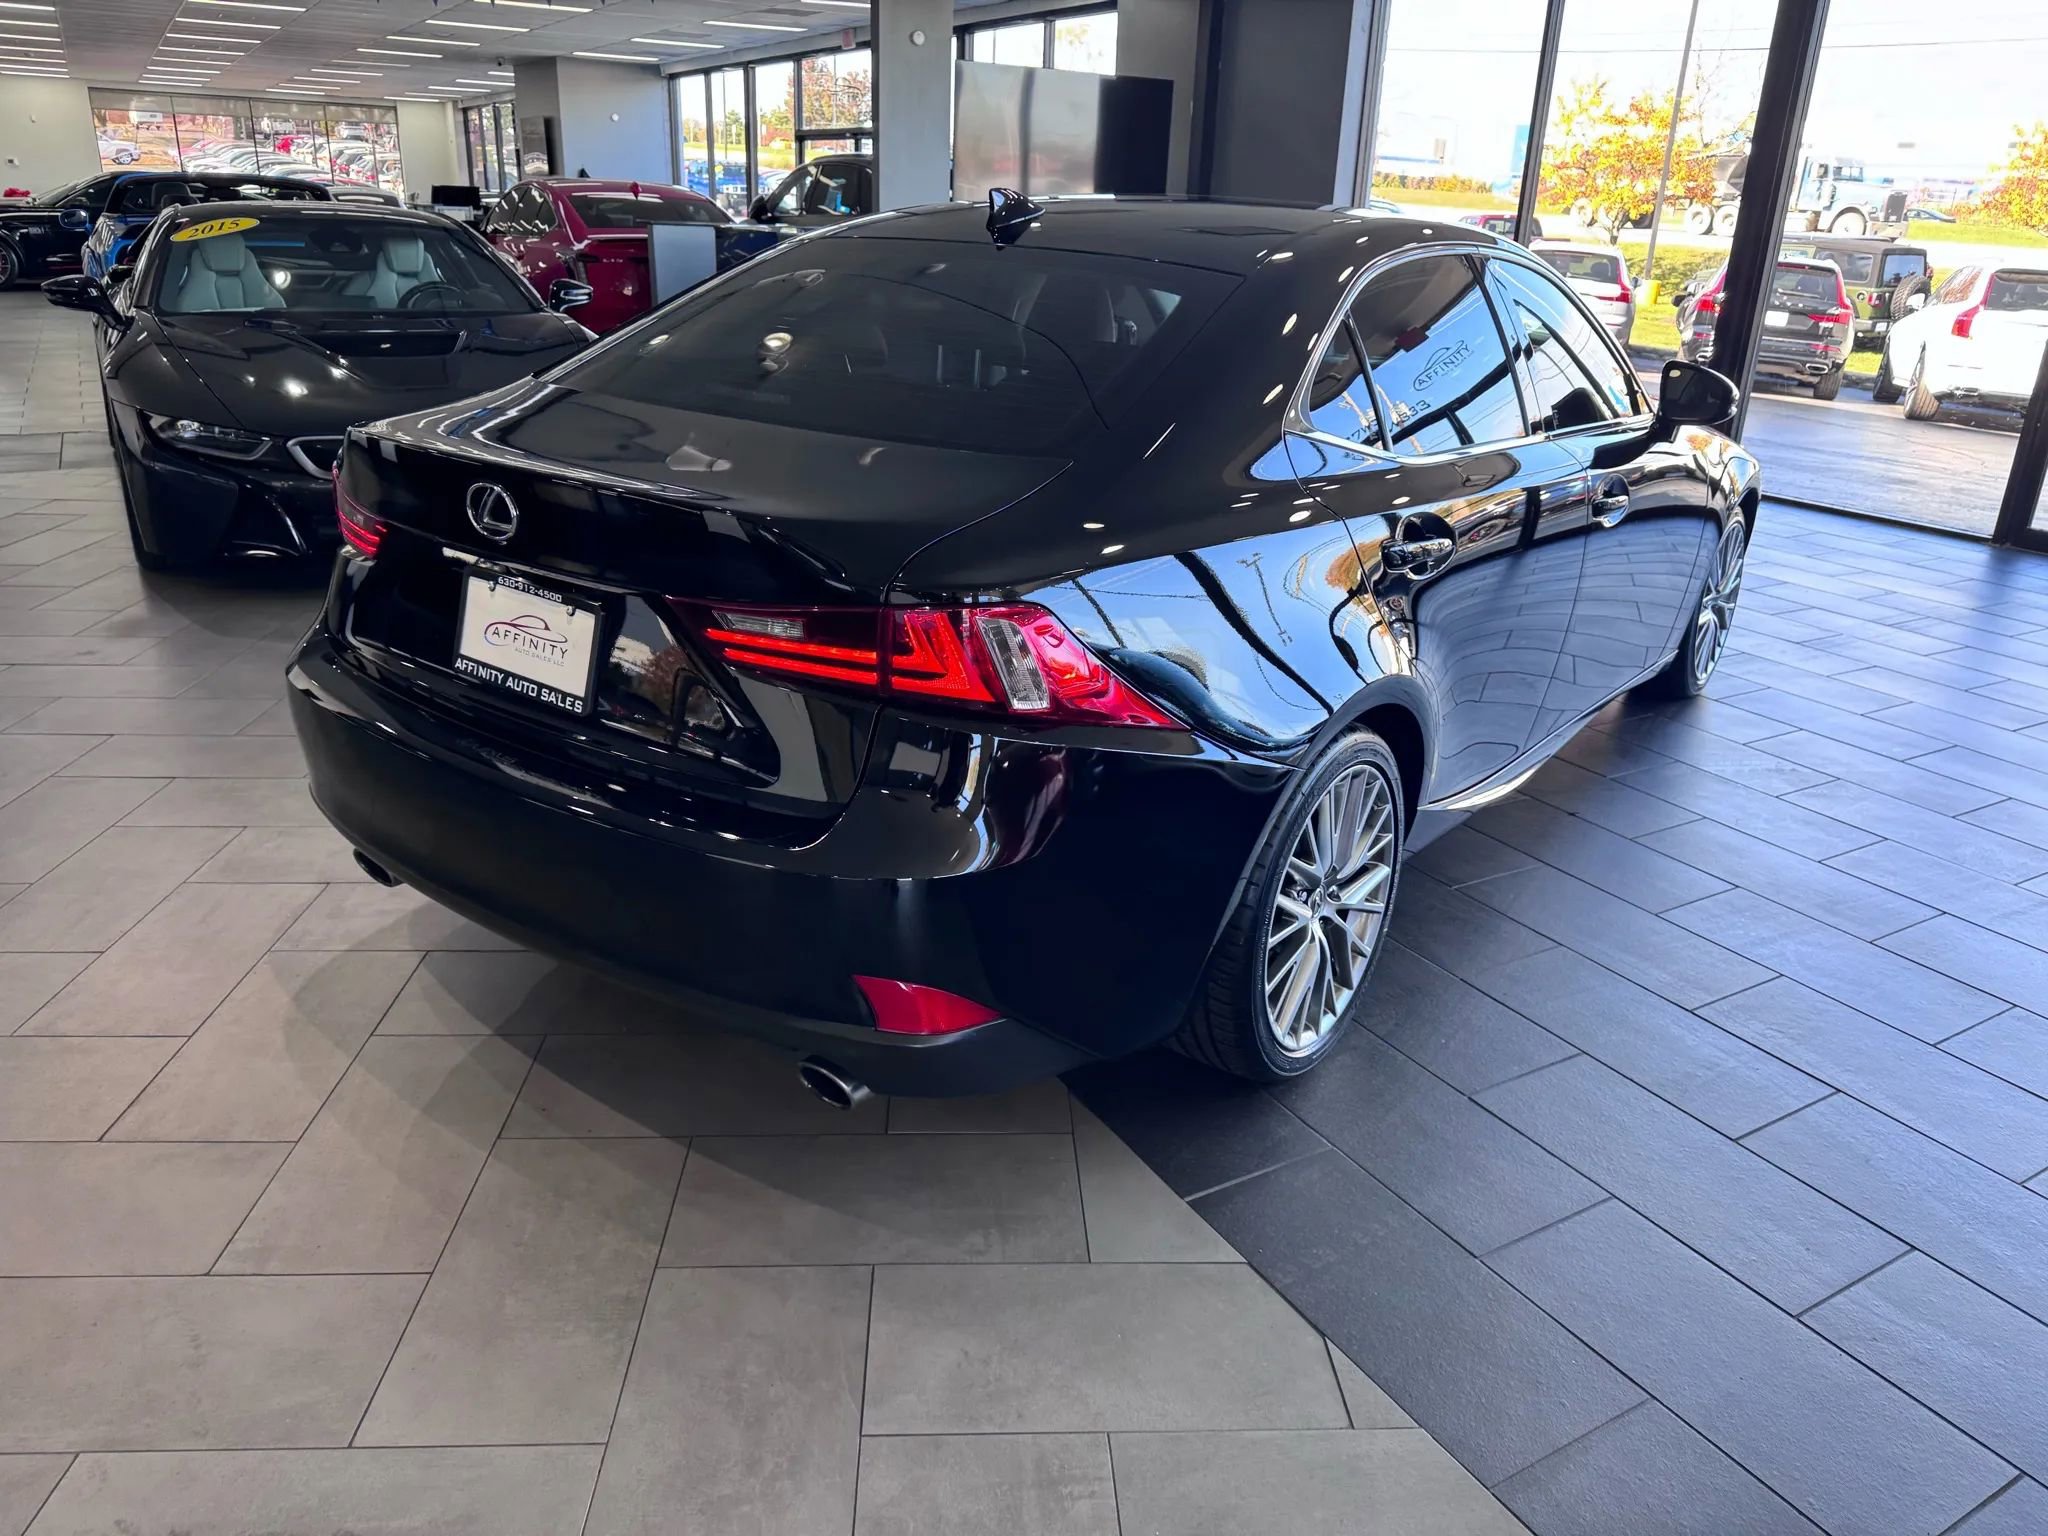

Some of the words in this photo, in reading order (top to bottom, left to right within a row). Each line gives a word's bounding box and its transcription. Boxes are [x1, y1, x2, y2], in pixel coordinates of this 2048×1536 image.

[186, 218, 241, 239] 2015
[1418, 343, 1471, 387] AFFINITY
[491, 626, 569, 659] AFFINITY
[454, 657, 505, 685] AFFINITY
[506, 676, 538, 697] AUTO
[540, 688, 584, 714] SALES
